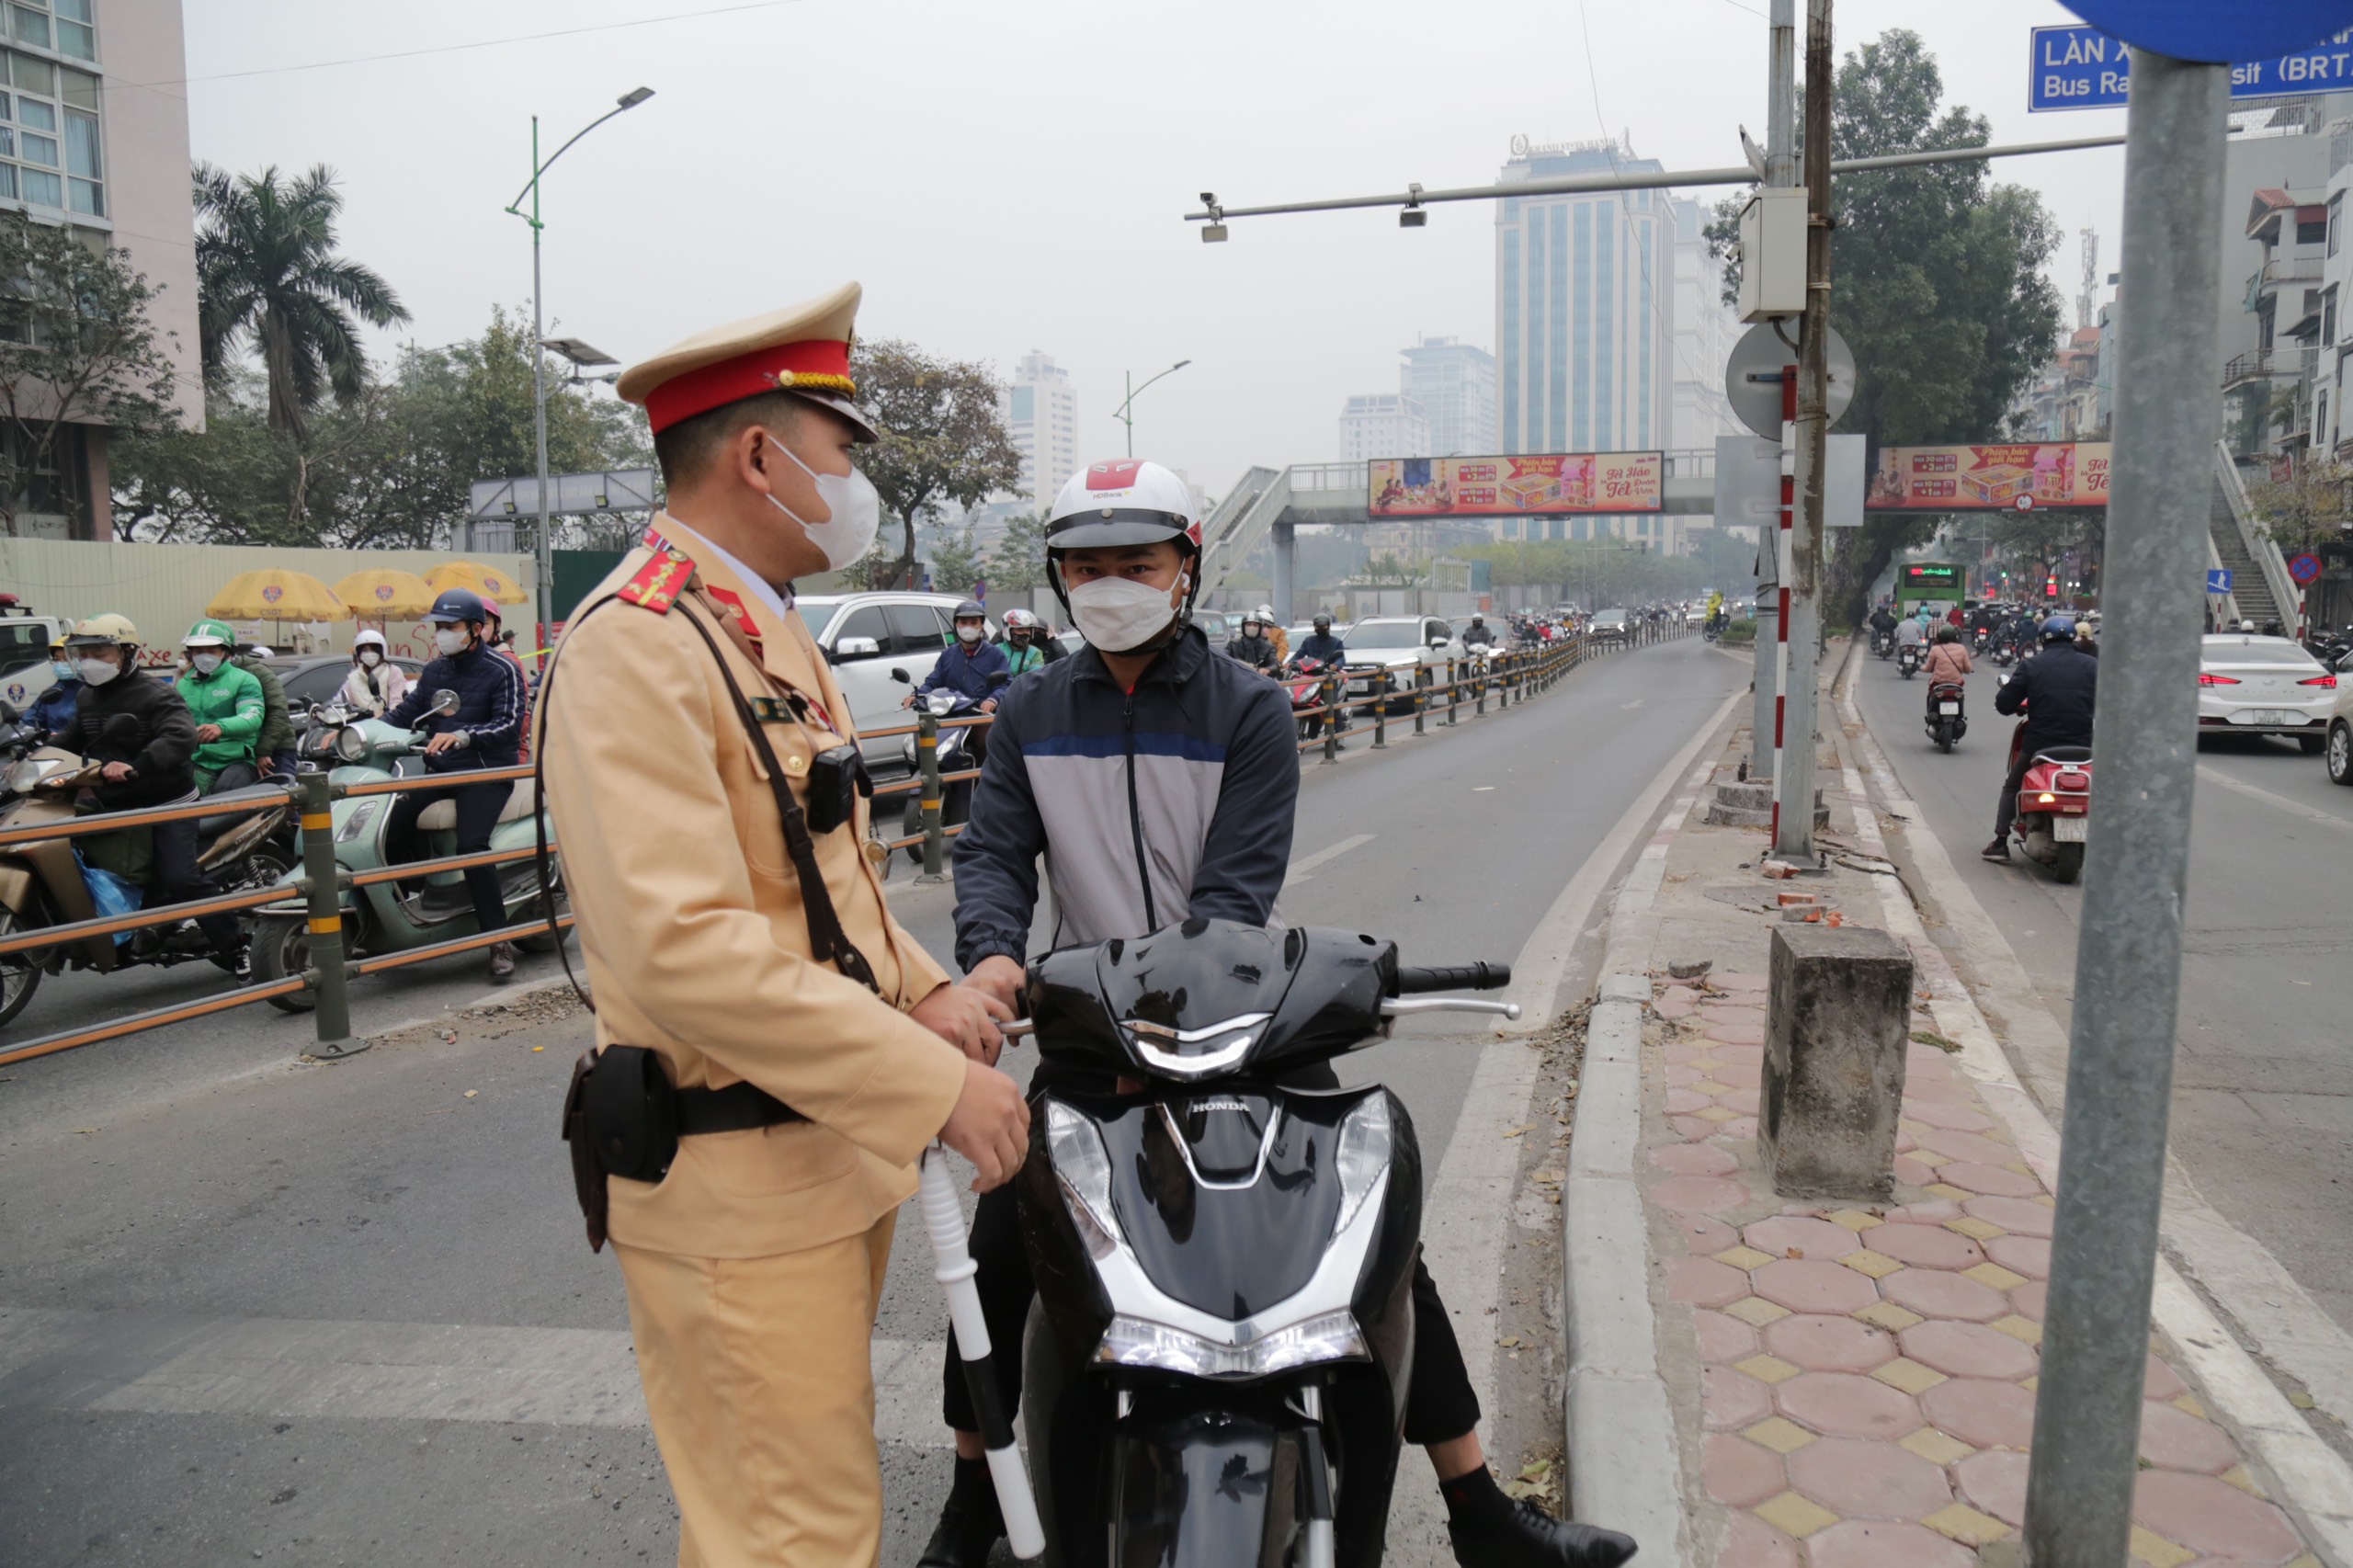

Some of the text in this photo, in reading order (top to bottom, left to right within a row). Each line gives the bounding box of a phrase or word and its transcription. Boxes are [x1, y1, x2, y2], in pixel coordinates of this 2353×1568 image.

[2045, 33, 2105, 67] LÀN
[2044, 75, 2090, 98] Bus
[1092, 491, 1123, 500] HDBank
[260, 608, 282, 617] CSGT
[212, 688, 230, 697] Grab
[1192, 1101, 1251, 1113] HONDA
